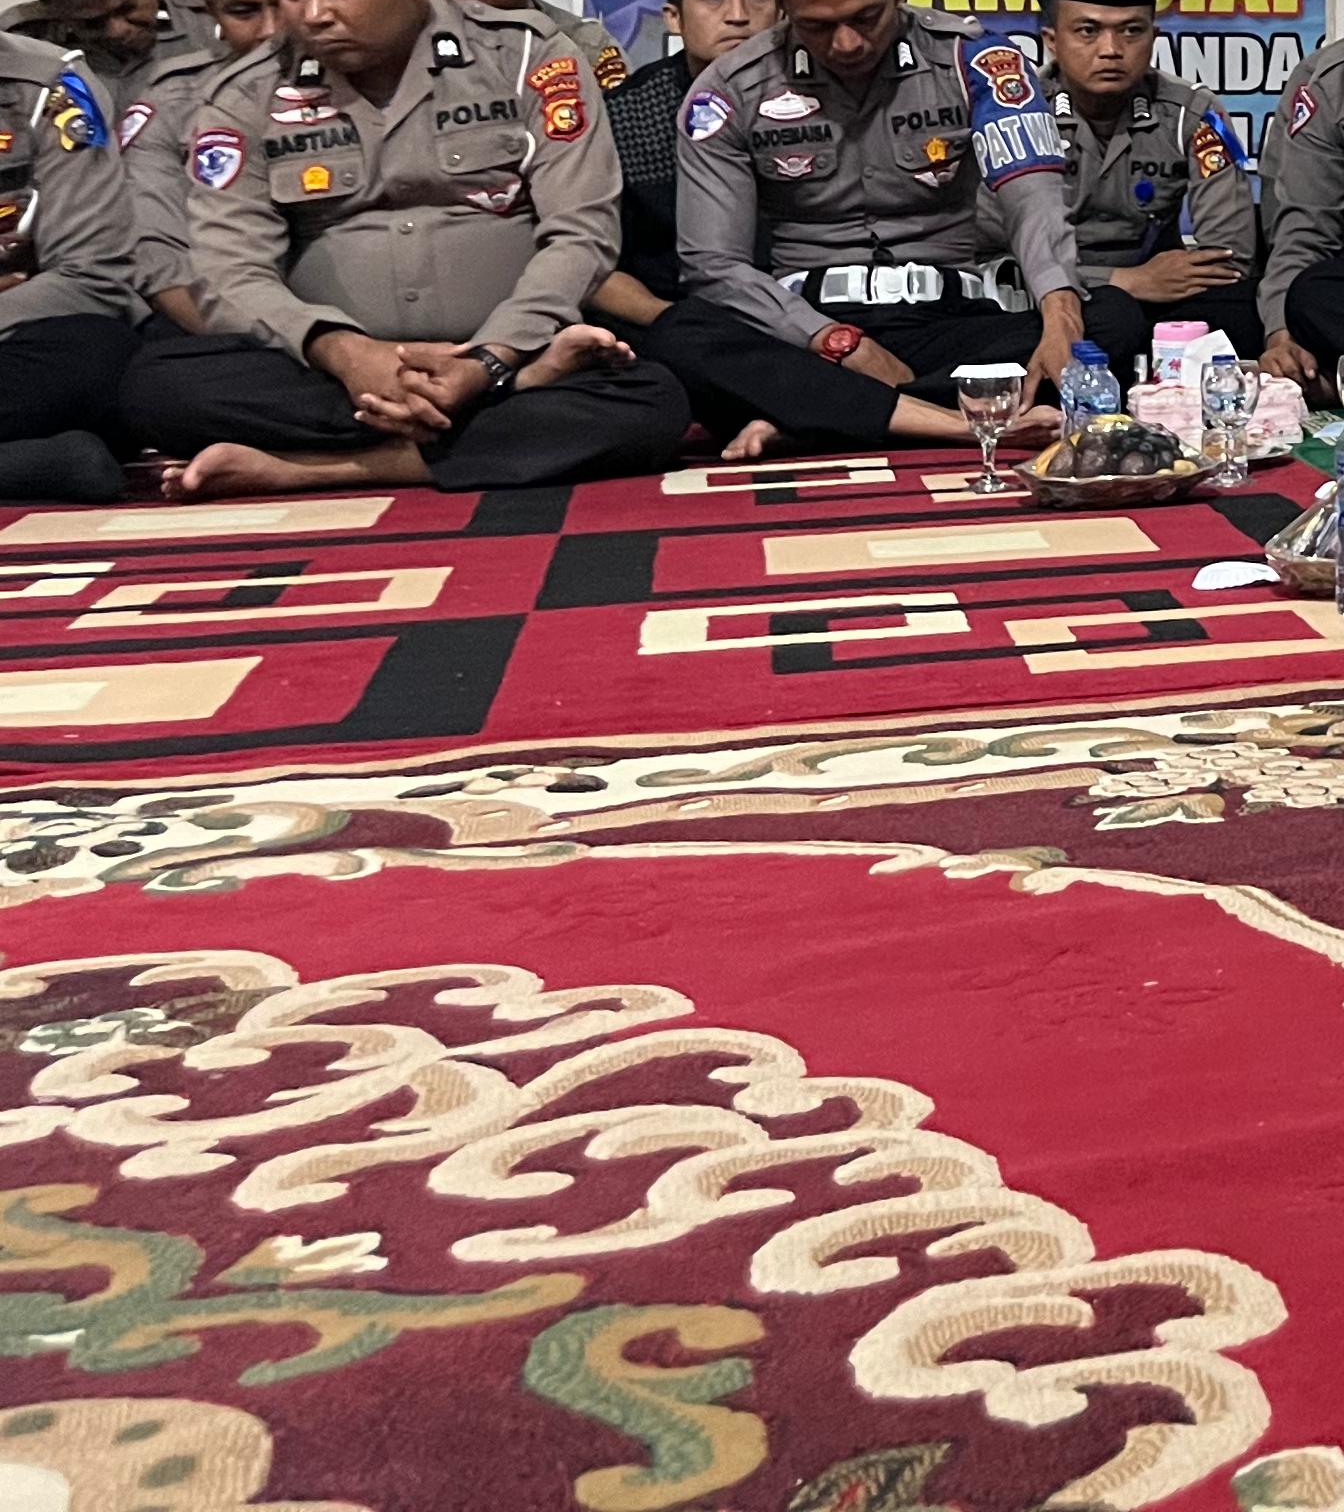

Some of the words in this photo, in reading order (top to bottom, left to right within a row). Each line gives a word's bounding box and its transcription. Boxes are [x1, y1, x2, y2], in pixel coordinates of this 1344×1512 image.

[437, 99, 518, 130] POLRI
[891, 106, 963, 135] POLRI
[264, 127, 361, 159] BASTIAN
